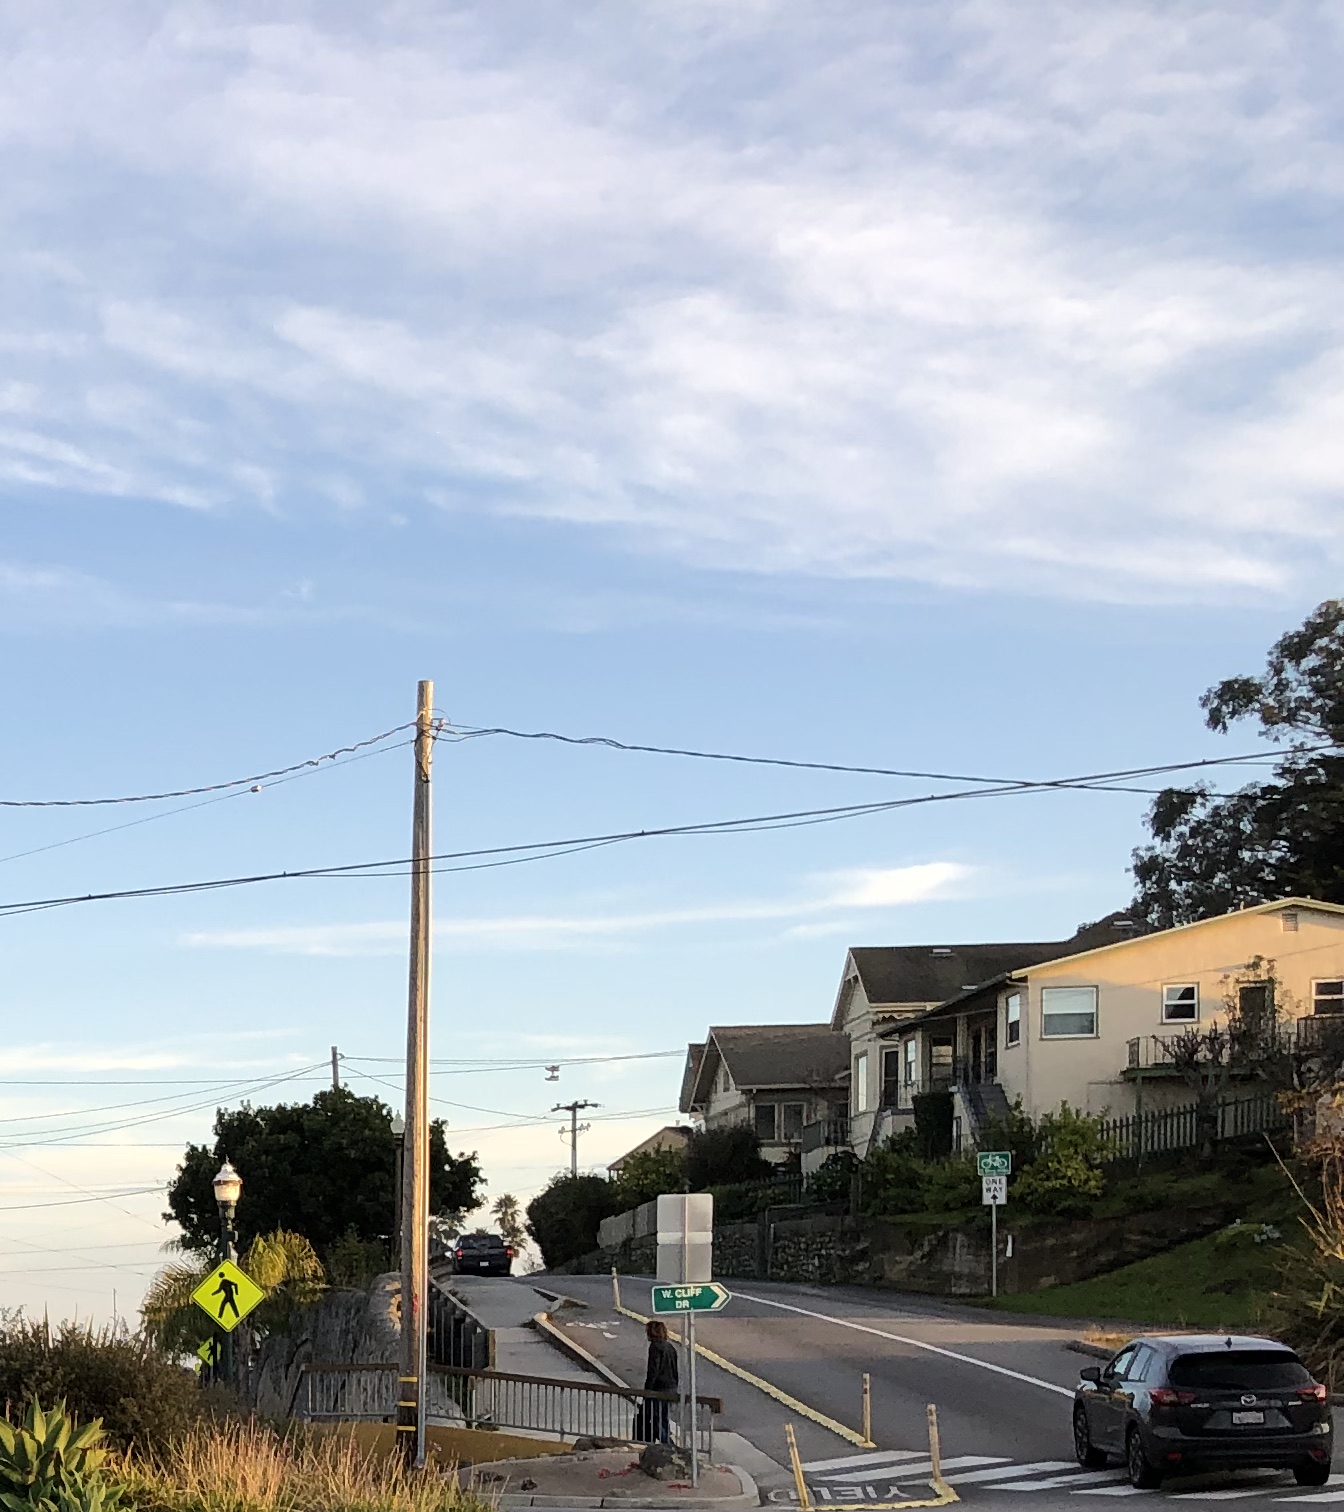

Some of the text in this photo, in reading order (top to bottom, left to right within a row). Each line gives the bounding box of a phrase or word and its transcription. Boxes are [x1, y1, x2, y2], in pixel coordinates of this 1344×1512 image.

[662, 1288, 702, 1298] W. CLIFF
[675, 1300, 689, 1308] DR
[767, 1485, 912, 1502] YIELD
